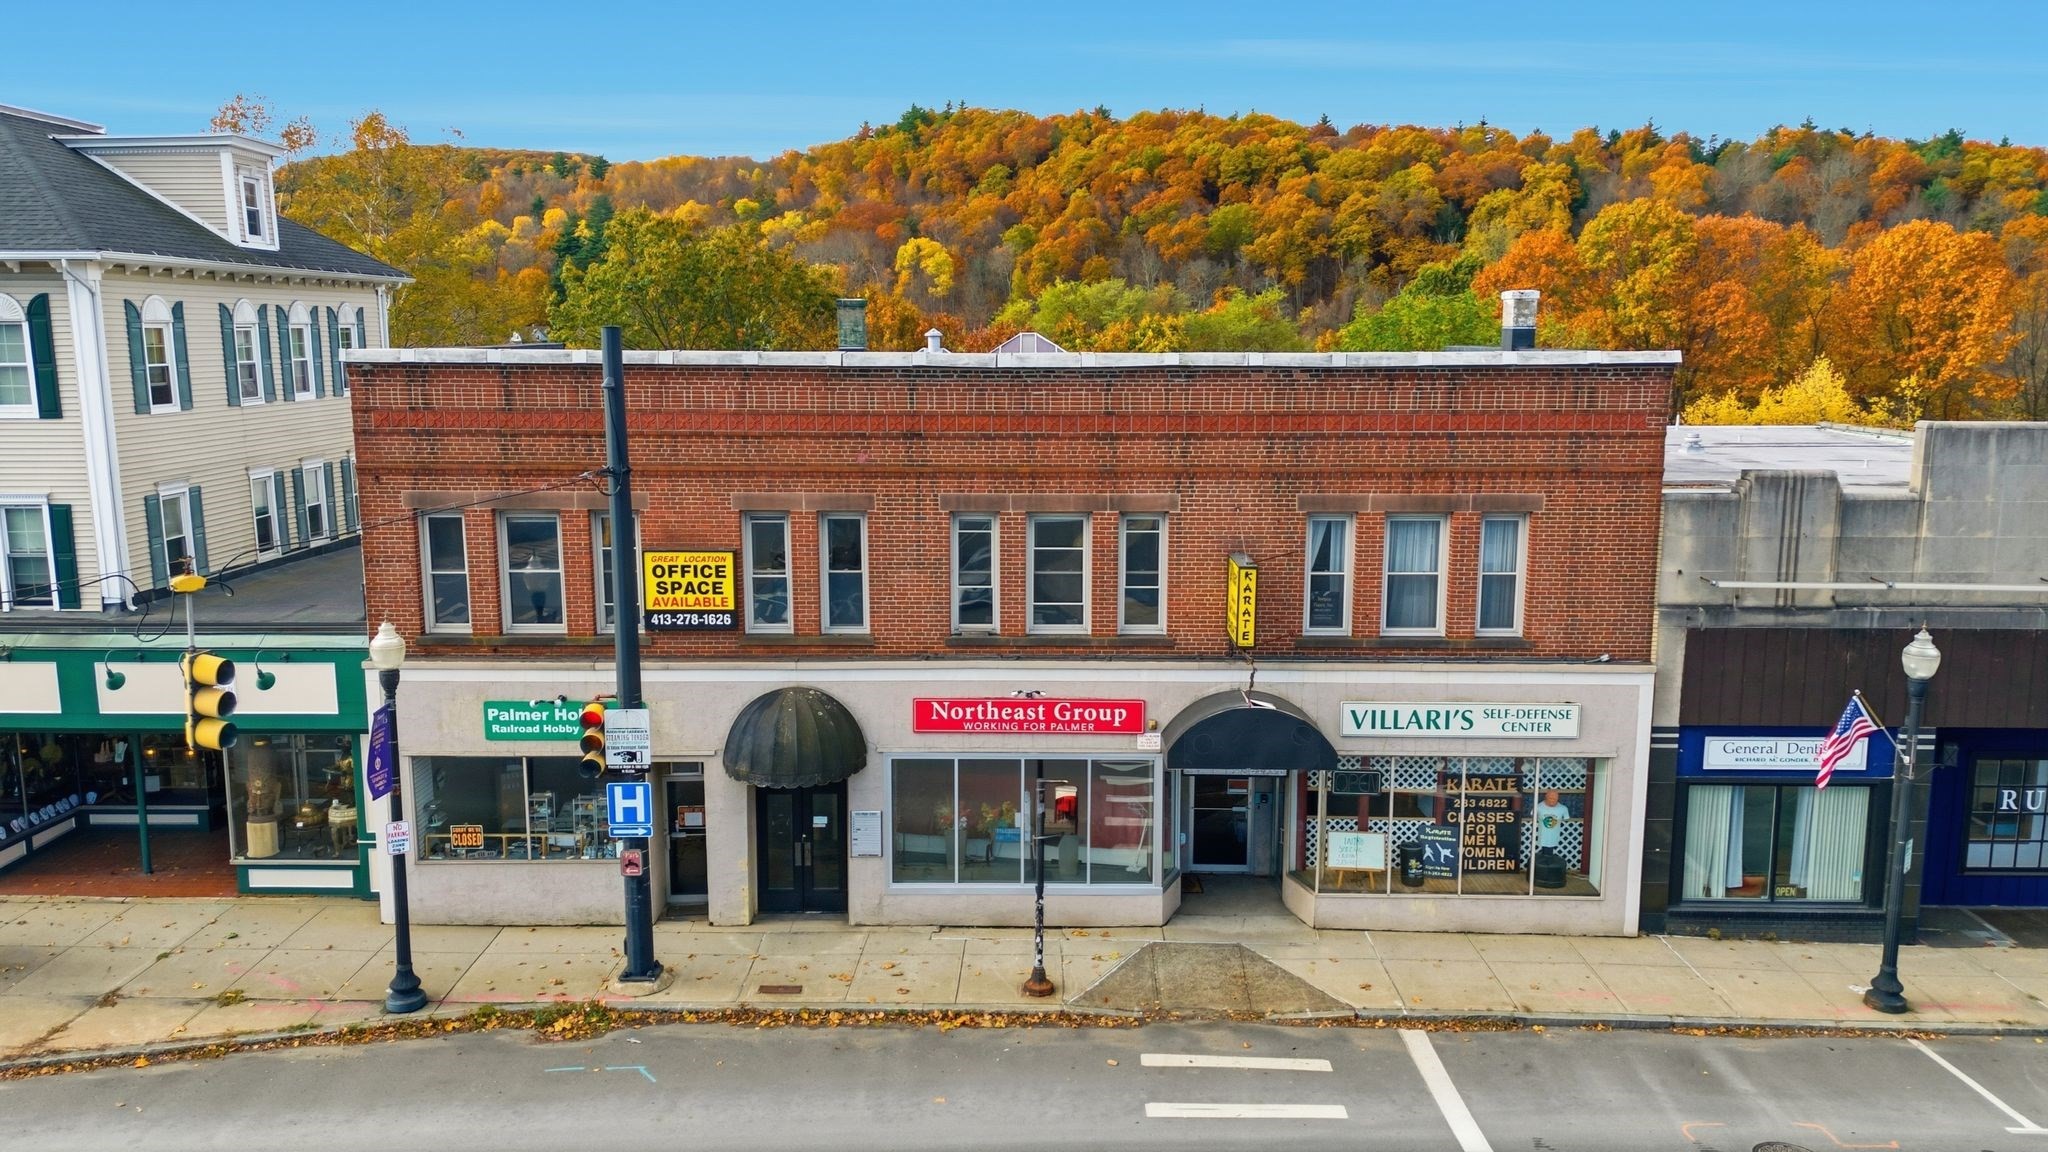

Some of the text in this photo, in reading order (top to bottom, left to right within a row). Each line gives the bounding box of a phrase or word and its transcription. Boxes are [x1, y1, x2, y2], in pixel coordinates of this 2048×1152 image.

[652, 564, 727, 578] OFFICE
[656, 581, 724, 595] SPACE
[652, 597, 729, 608] AVAILABLE
[1242, 571, 1253, 641] KARATE
[651, 613, 731, 625] 413-278-1626
[487, 708, 549, 721] Palmer
[931, 701, 1127, 726] Northeast Group
[1350, 708, 1572, 731] VILLARI'S SELF-DEFENSE
[491, 724, 579, 735] Railroad Hobby
[963, 721, 1094, 732] WORKING FOR PALMER
[1501, 721, 1551, 733] CENTER
[1723, 742, 1828, 755] General Dentis
[1446, 777, 1518, 792] KARATE
[614, 786, 646, 823] H
[1479, 799, 1508, 808] 4822
[1447, 812, 1514, 823] CLASSES
[1466, 824, 1496, 834] FOR
[453, 834, 482, 846] CLOSED
[1464, 835, 1496, 846] MEN
[1463, 860, 1515, 870] ILDREN
[1775, 886, 1796, 897] OPEN
